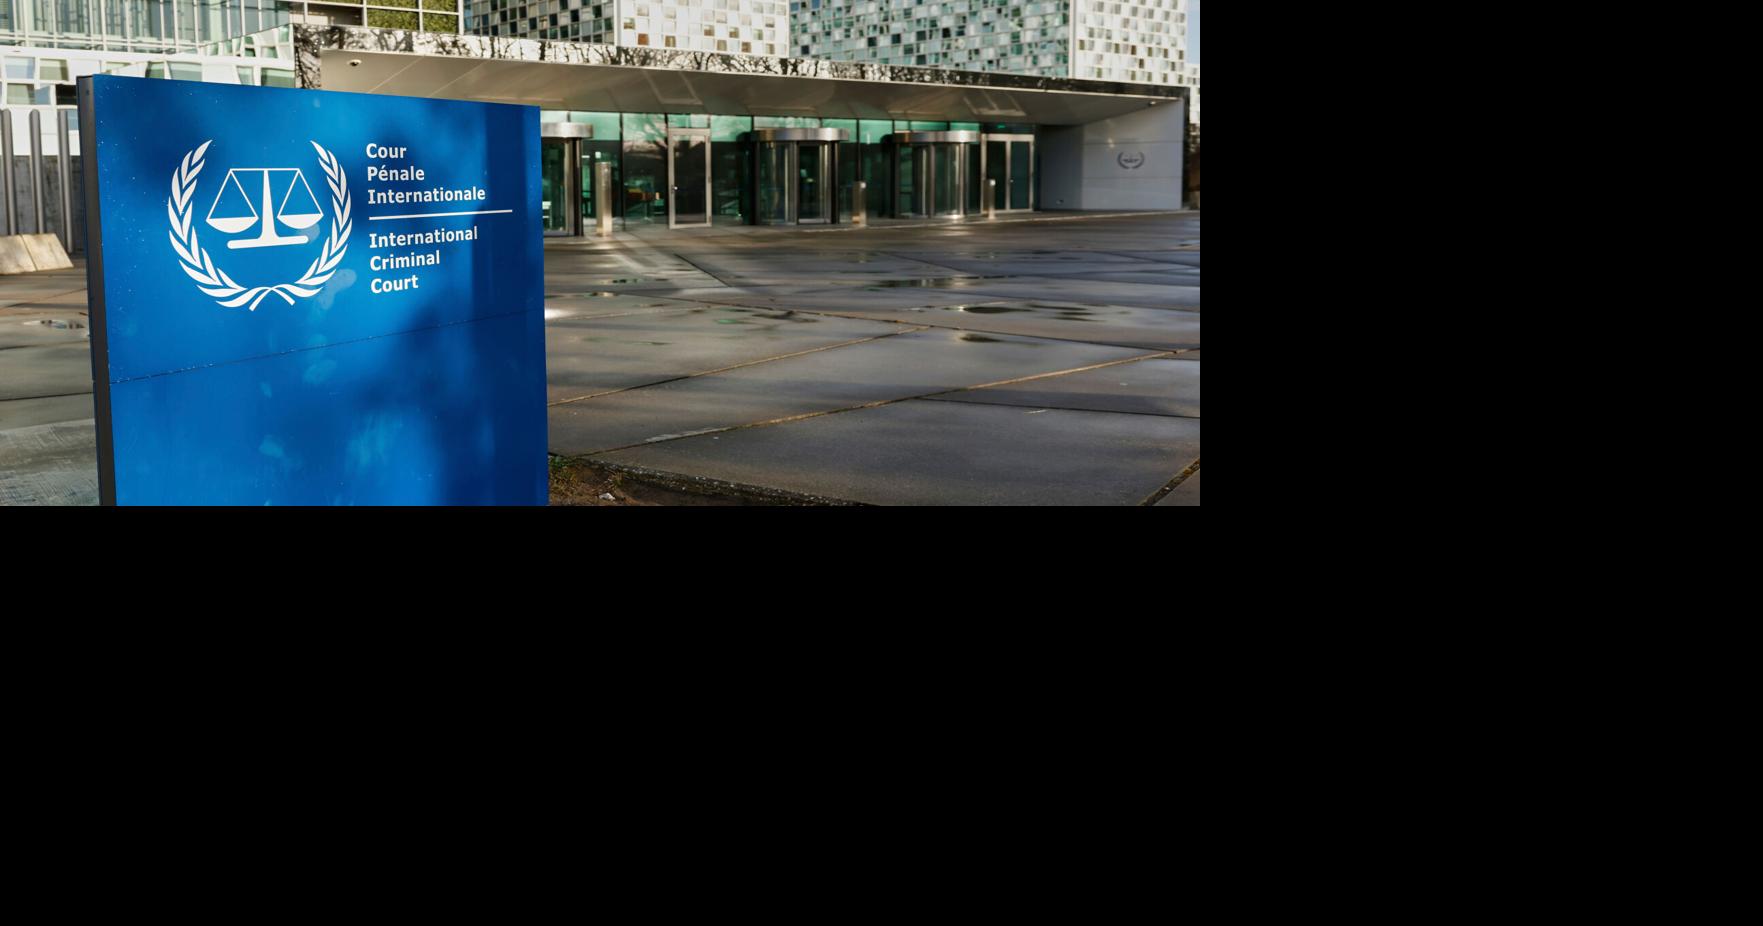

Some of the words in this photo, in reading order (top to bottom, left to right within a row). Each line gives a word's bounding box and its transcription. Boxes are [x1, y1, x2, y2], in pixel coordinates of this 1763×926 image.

[366, 143, 407, 159] Cour
[367, 165, 425, 181] Pénale
[367, 186, 486, 204] Internationale
[369, 226, 478, 248] International
[370, 250, 440, 271] Criminal
[370, 274, 419, 294] Court
